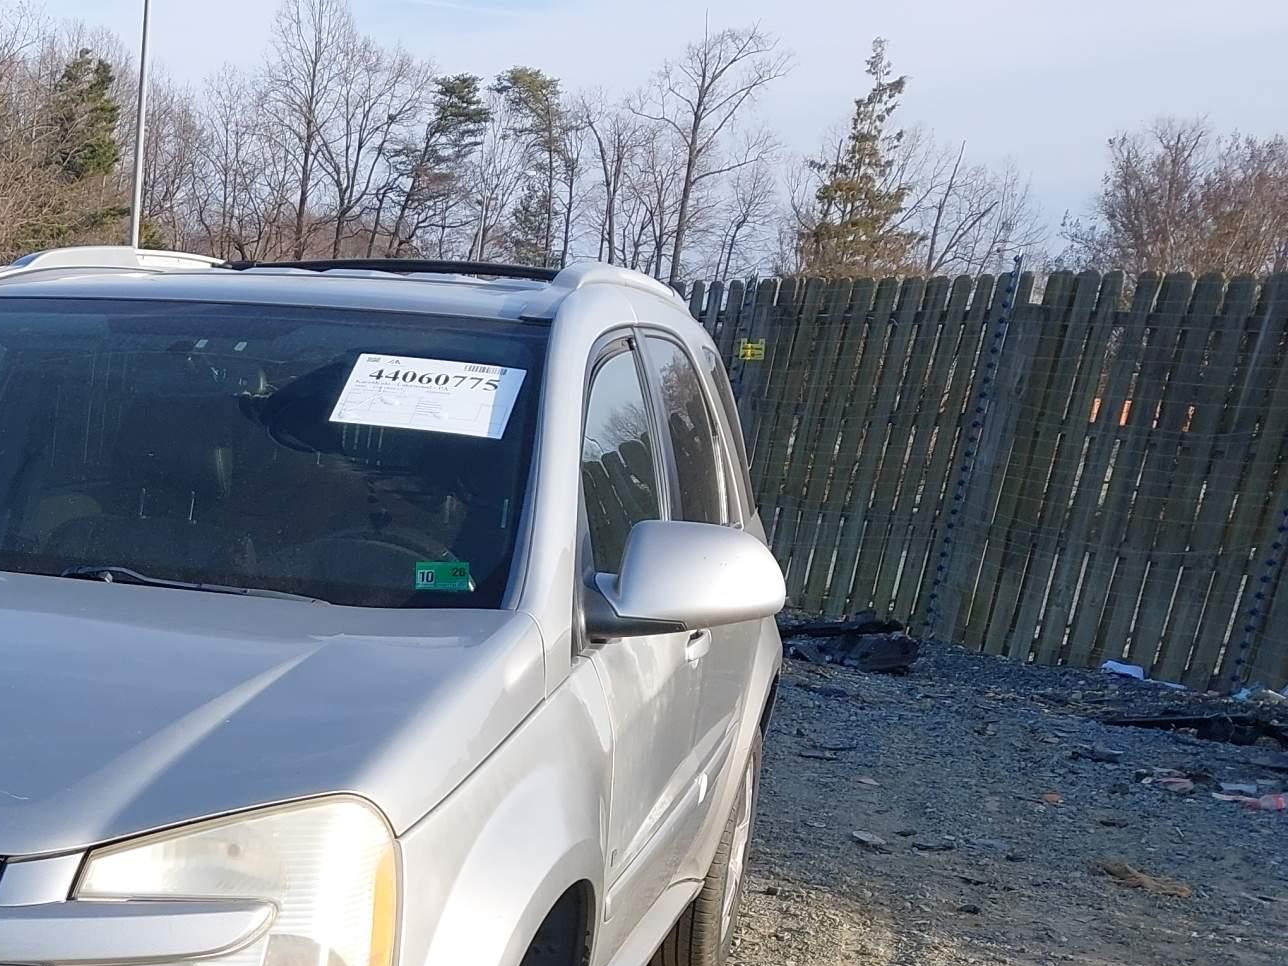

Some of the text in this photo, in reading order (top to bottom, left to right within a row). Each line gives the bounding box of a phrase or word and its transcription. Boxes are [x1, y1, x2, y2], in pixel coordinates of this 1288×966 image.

[369, 368, 500, 392] 44060775
[419, 571, 434, 583] 10
[452, 567, 466, 577] 26
